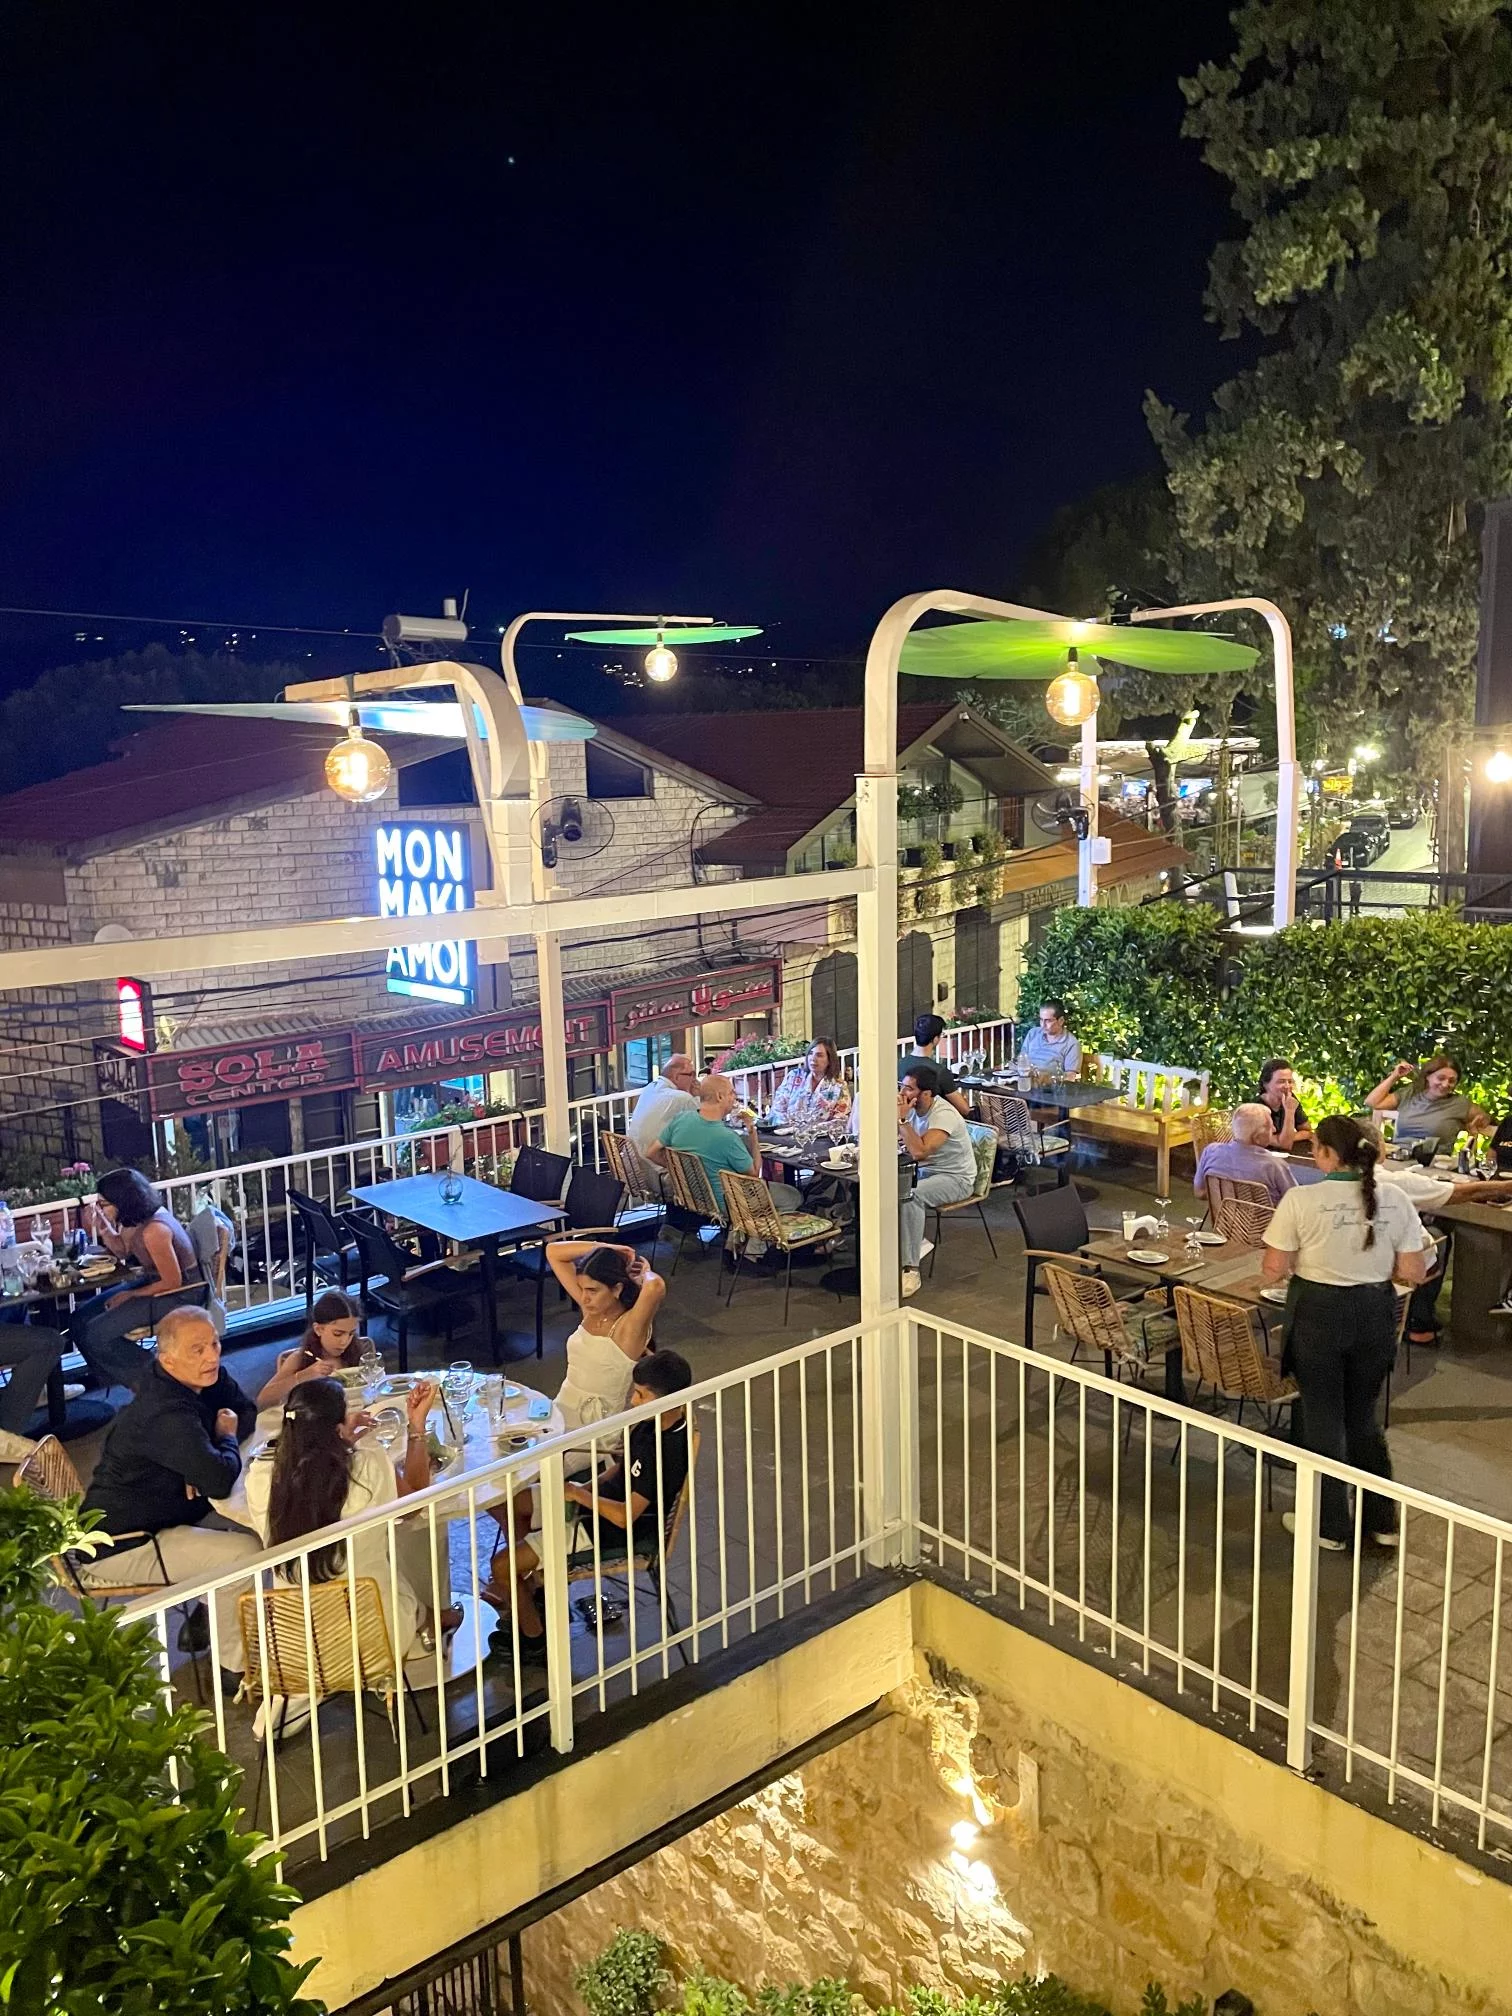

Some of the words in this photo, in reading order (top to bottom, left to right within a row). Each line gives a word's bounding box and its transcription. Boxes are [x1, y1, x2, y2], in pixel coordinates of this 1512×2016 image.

[376, 828, 463, 881] MON
[379, 877, 465, 918] MAKI
[385, 940, 468, 987] AMOI
[178, 1041, 331, 1093] SOLA
